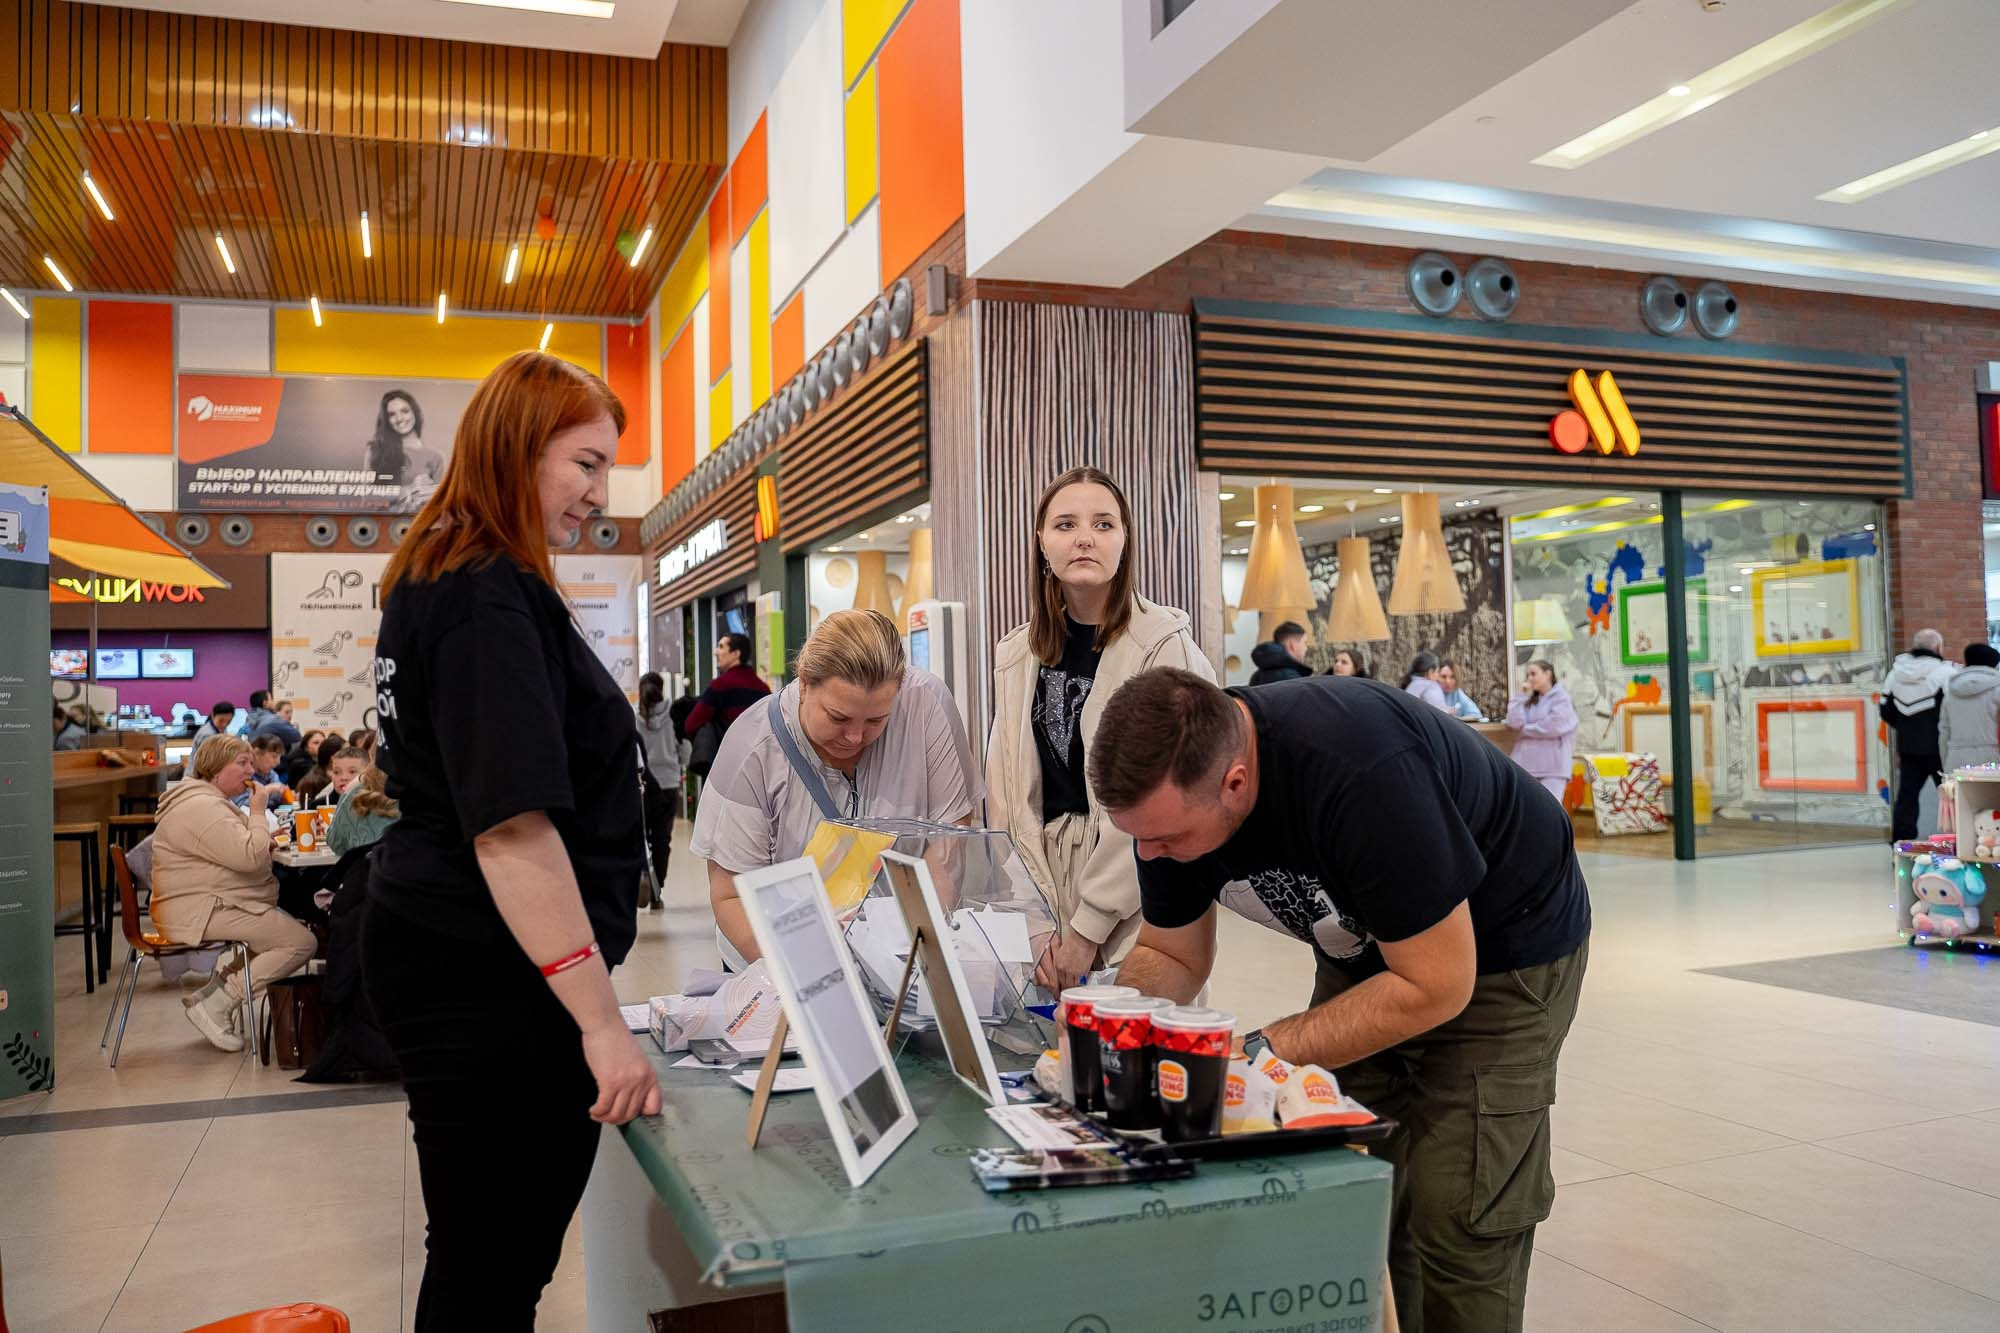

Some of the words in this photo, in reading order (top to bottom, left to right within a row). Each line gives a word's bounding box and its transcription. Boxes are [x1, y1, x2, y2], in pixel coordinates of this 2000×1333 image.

[195, 467, 256, 481] ВЫБОР
[258, 468, 377, 483] НАПРАВЛЕНИЯ
[187, 481, 251, 494] START-UP
[252, 482, 263, 494] В
[265, 482, 338, 496] УСПЕШНОЕ
[338, 483, 401, 497] БУДУЩЕЕ
[1197, 1277, 1368, 1322] ЗАГОРОД
